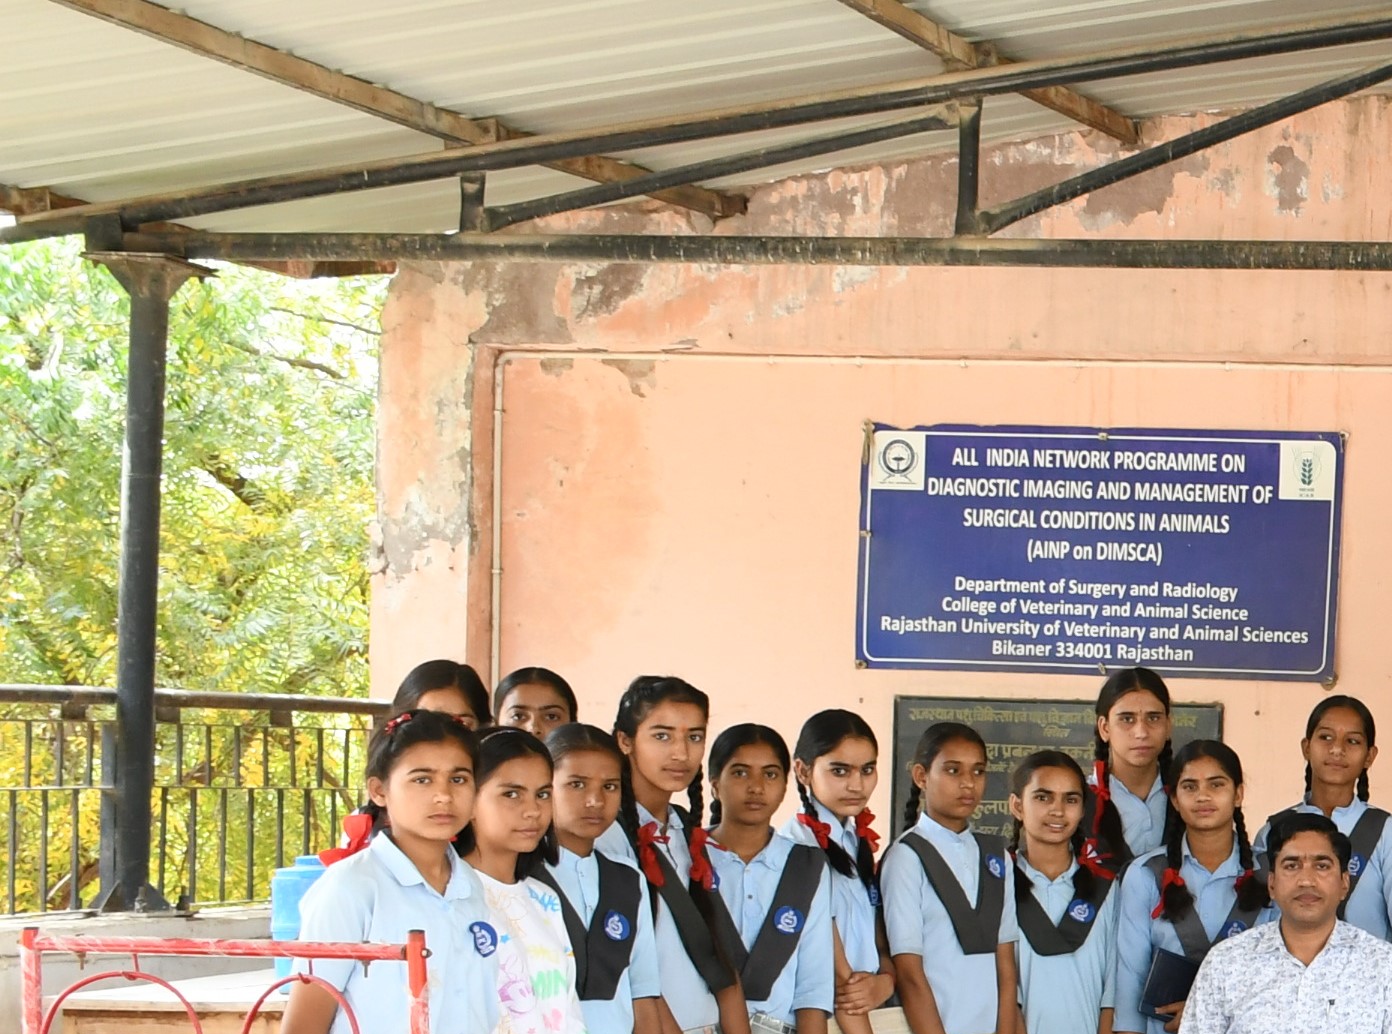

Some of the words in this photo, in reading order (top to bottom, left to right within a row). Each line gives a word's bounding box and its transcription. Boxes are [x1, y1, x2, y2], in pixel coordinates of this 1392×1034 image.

[952, 448, 978, 466] ALL
[987, 449, 1029, 467] INDIA
[1034, 450, 1110, 468] NETWORK
[1114, 452, 1217, 471] PROGRAMME
[1222, 454, 1245, 472] ON
[928, 478, 1020, 497] DIAGNOSTIC
[1024, 480, 1092, 499] IMAGING
[1097, 482, 1130, 500] AND
[1135, 483, 1249, 503] MANAGEMENT
[1253, 486, 1273, 503] OF
[963, 509, 1037, 528] SURGICAL
[1041, 510, 1135, 530] CONDITIONS
[1139, 513, 1155, 531] IN
[1159, 514, 1229, 533] ANIMALS
[1028, 539, 1070, 562] (AINP
[1073, 546, 1092, 559] on
[1097, 542, 1162, 565] DIMSCA)
[955, 577, 1045, 594] Department
[1049, 579, 1065, 593] of
[1068, 580, 1126, 599] Surgery
[1130, 582, 1158, 596] and
[1163, 583, 1238, 602] Radiology
[942, 597, 996, 615] College
[1000, 598, 1016, 613] of
[1020, 600, 1098, 619] Veterinary
[1102, 602, 1130, 616] and
[1134, 603, 1188, 618] Animal
[1192, 605, 1248, 620] Science
[881, 616, 956, 634] Rajasthan
[962, 618, 1040, 638] University
[1044, 620, 1061, 635] of
[1064, 621, 1145, 641] Veterinary
[1150, 624, 1179, 639] and
[1183, 625, 1238, 641] Animal
[1243, 627, 1308, 643] Sciences
[992, 640, 1052, 656] Bikaner
[1056, 642, 1112, 658] 334001
[1117, 644, 1193, 663] Rajasthan
